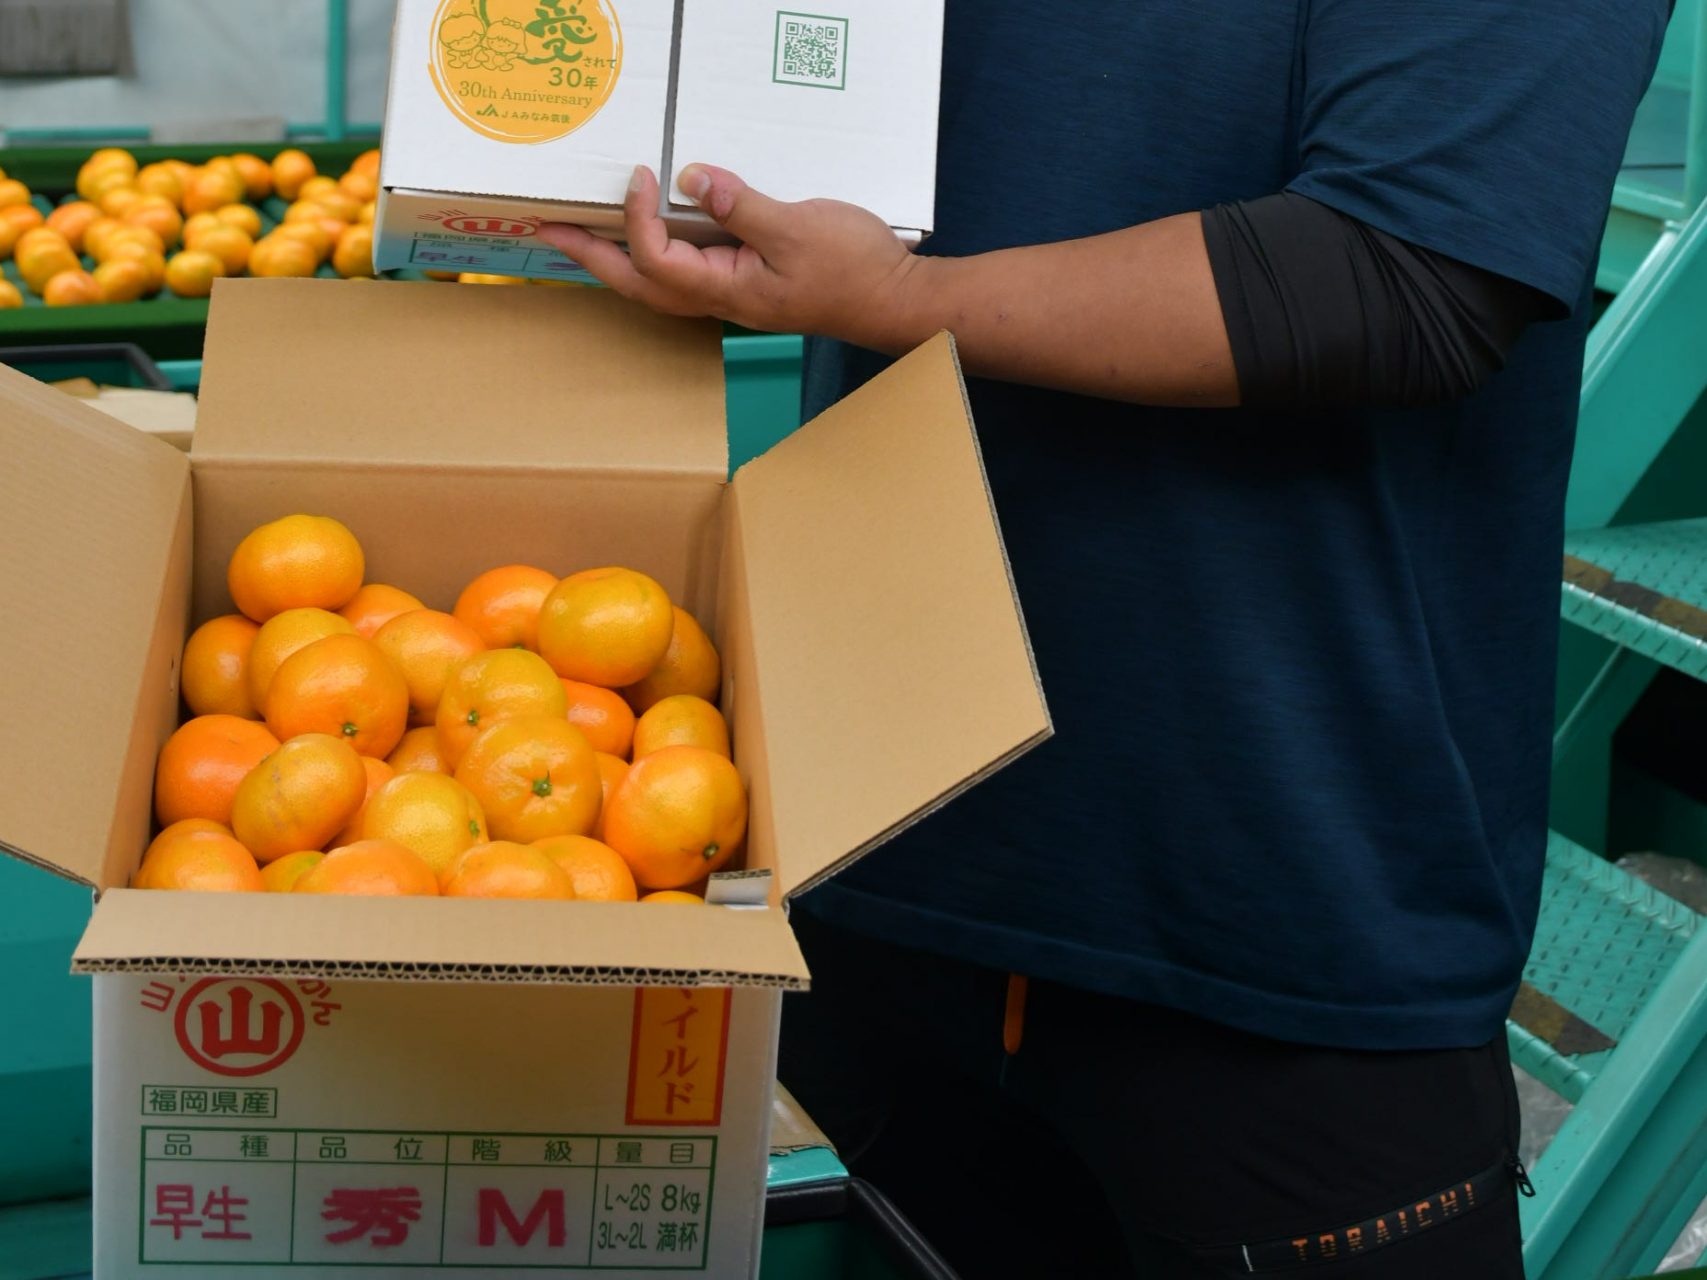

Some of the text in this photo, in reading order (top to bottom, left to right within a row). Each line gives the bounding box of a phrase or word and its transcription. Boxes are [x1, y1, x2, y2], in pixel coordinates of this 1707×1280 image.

[458, 80, 593, 109] 30th Anniversary
[548, 66, 599, 90] 30年
[197, 986, 285, 1059] 山
[656, 987, 699, 1116] イルド
[149, 1089, 270, 1114] 福岡県産
[150, 1184, 252, 1240] 早生
[476, 1187, 567, 1248] M
[656, 1221, 699, 1252] 満杯
[1292, 1182, 1475, 1261] TORAICHI
